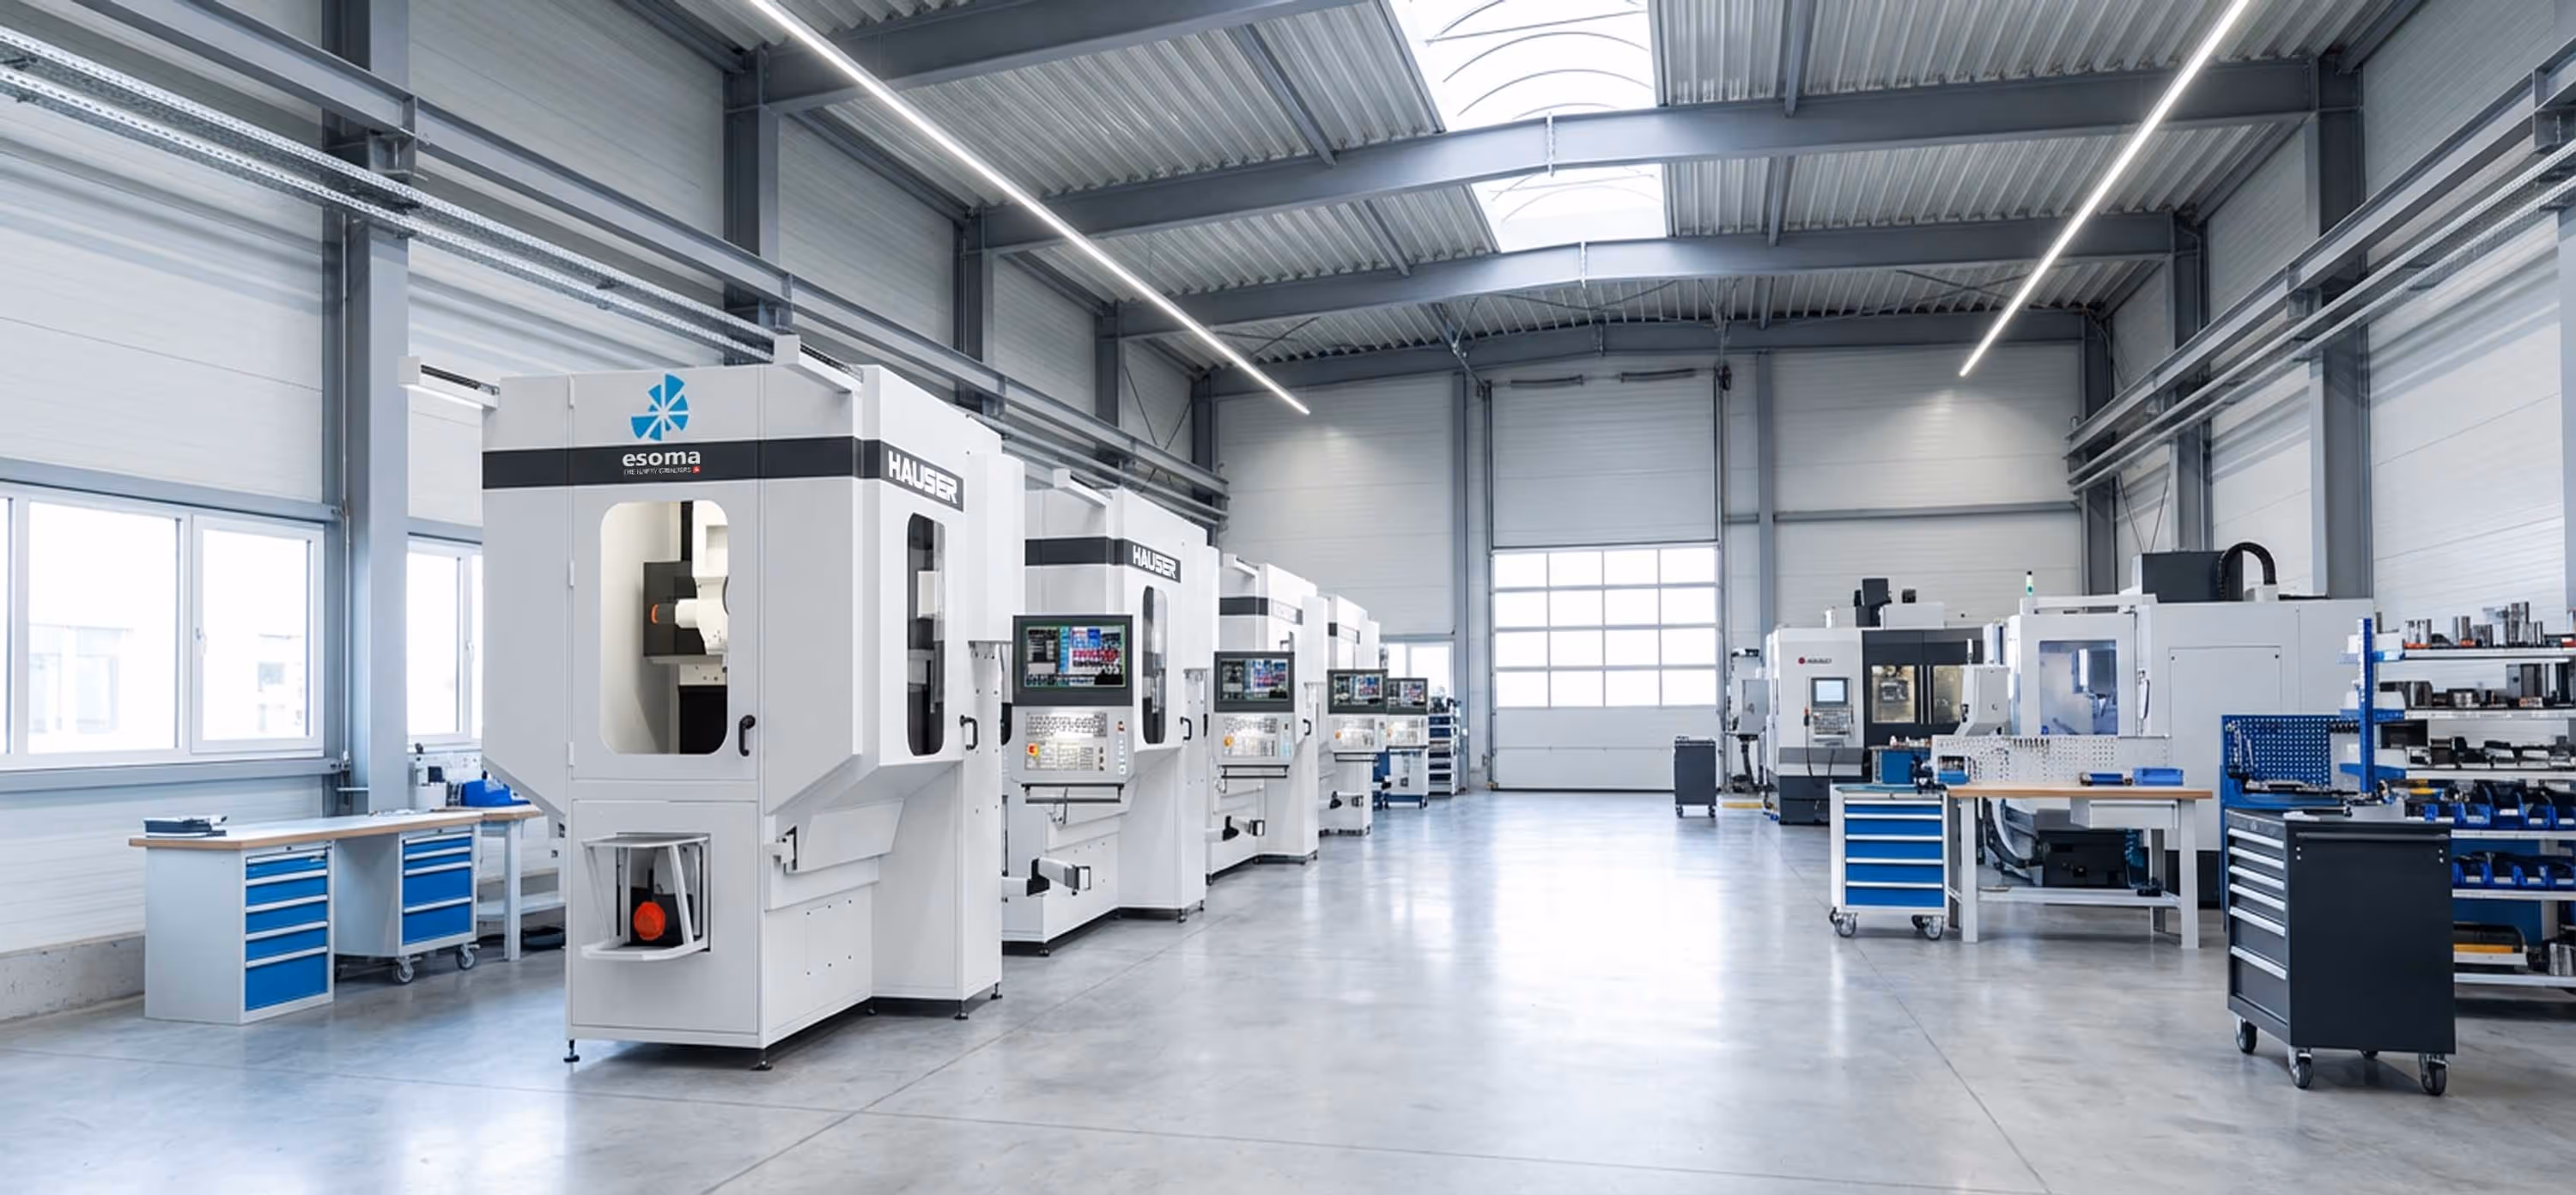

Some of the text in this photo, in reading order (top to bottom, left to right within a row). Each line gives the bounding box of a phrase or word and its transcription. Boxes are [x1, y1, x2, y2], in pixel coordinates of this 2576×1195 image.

[623, 451, 701, 467] esoma
[888, 450, 957, 504] HAUSER
[1133, 545, 1176, 579] HAUSER
